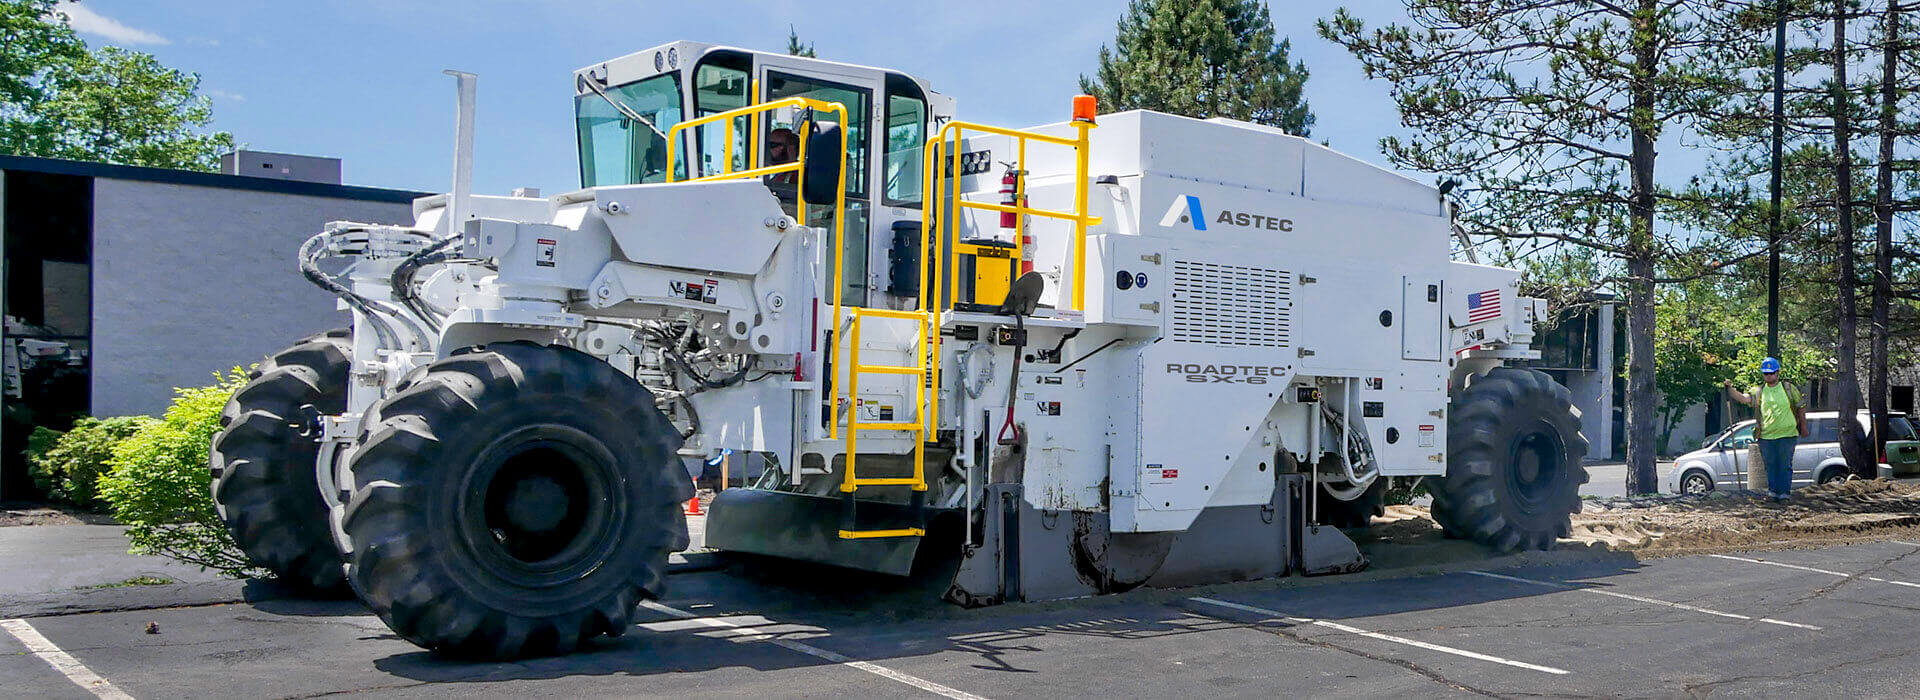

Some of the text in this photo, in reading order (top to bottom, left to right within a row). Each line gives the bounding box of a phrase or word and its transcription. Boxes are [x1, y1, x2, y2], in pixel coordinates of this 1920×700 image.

[1216, 210, 1293, 232] ASTEC
[1166, 363, 1286, 377] ROADTEC
[1186, 374, 1267, 385] SX-6
